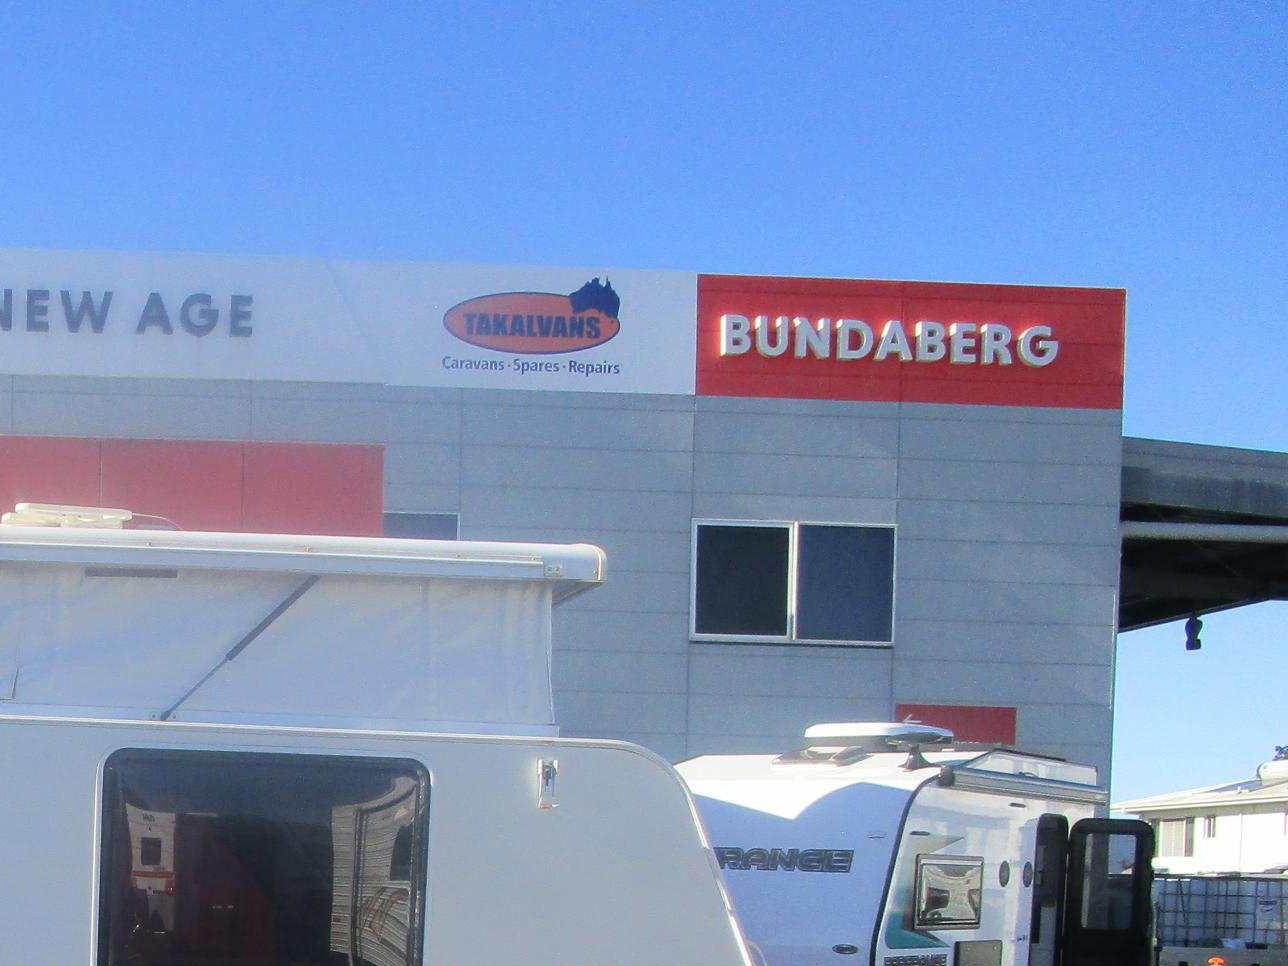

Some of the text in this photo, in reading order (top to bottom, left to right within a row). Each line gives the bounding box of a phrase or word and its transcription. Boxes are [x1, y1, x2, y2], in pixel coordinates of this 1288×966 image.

[135, 292, 253, 338] AGE
[463, 313, 601, 340] TAKALVANS
[720, 314, 1059, 367] BUNDABERG
[442, 356, 620, 377] Caravans Spares Repairs
